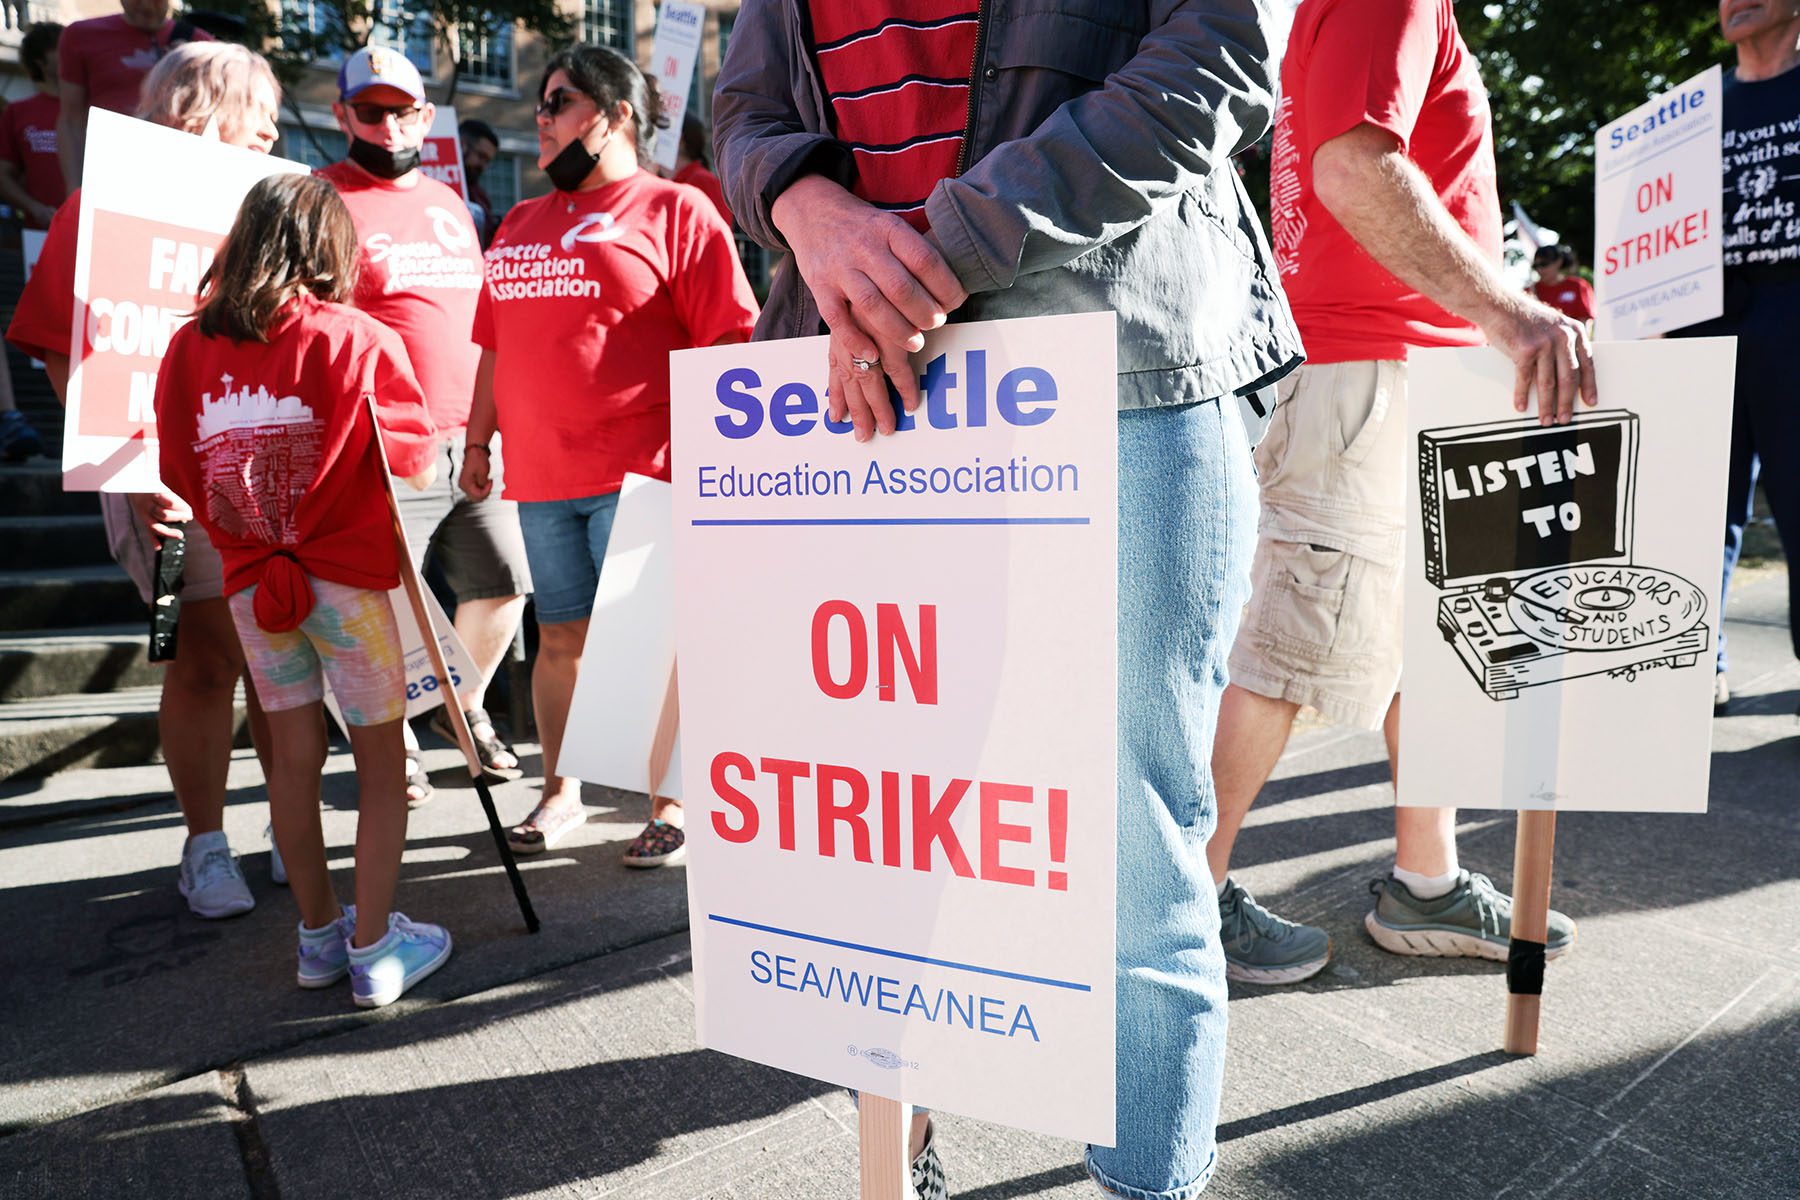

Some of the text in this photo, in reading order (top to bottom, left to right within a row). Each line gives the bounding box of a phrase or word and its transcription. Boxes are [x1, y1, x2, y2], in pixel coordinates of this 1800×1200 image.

[1611, 90, 1705, 149] Seattle
[1736, 124, 1776, 149] you
[1733, 141, 1780, 167] with
[1637, 172, 1673, 213] ON
[1604, 209, 1708, 275] STRIKE!
[1760, 220, 1782, 244] of
[485, 257, 585, 283] Education
[87, 297, 194, 358] CONT
[714, 350, 1058, 440] Setle
[698, 456, 1079, 498] Education Association
[1444, 442, 1595, 500] LISTEN
[1522, 502, 1581, 538] TO
[1530, 570, 1680, 605] EDUCATORS
[1563, 615, 1670, 644] STUDENTS
[1592, 612, 1627, 623] AND
[811, 599, 938, 706] ON
[710, 751, 1068, 892] STRIKE!
[750, 951, 1040, 1043] SEA/WEA/NEA
